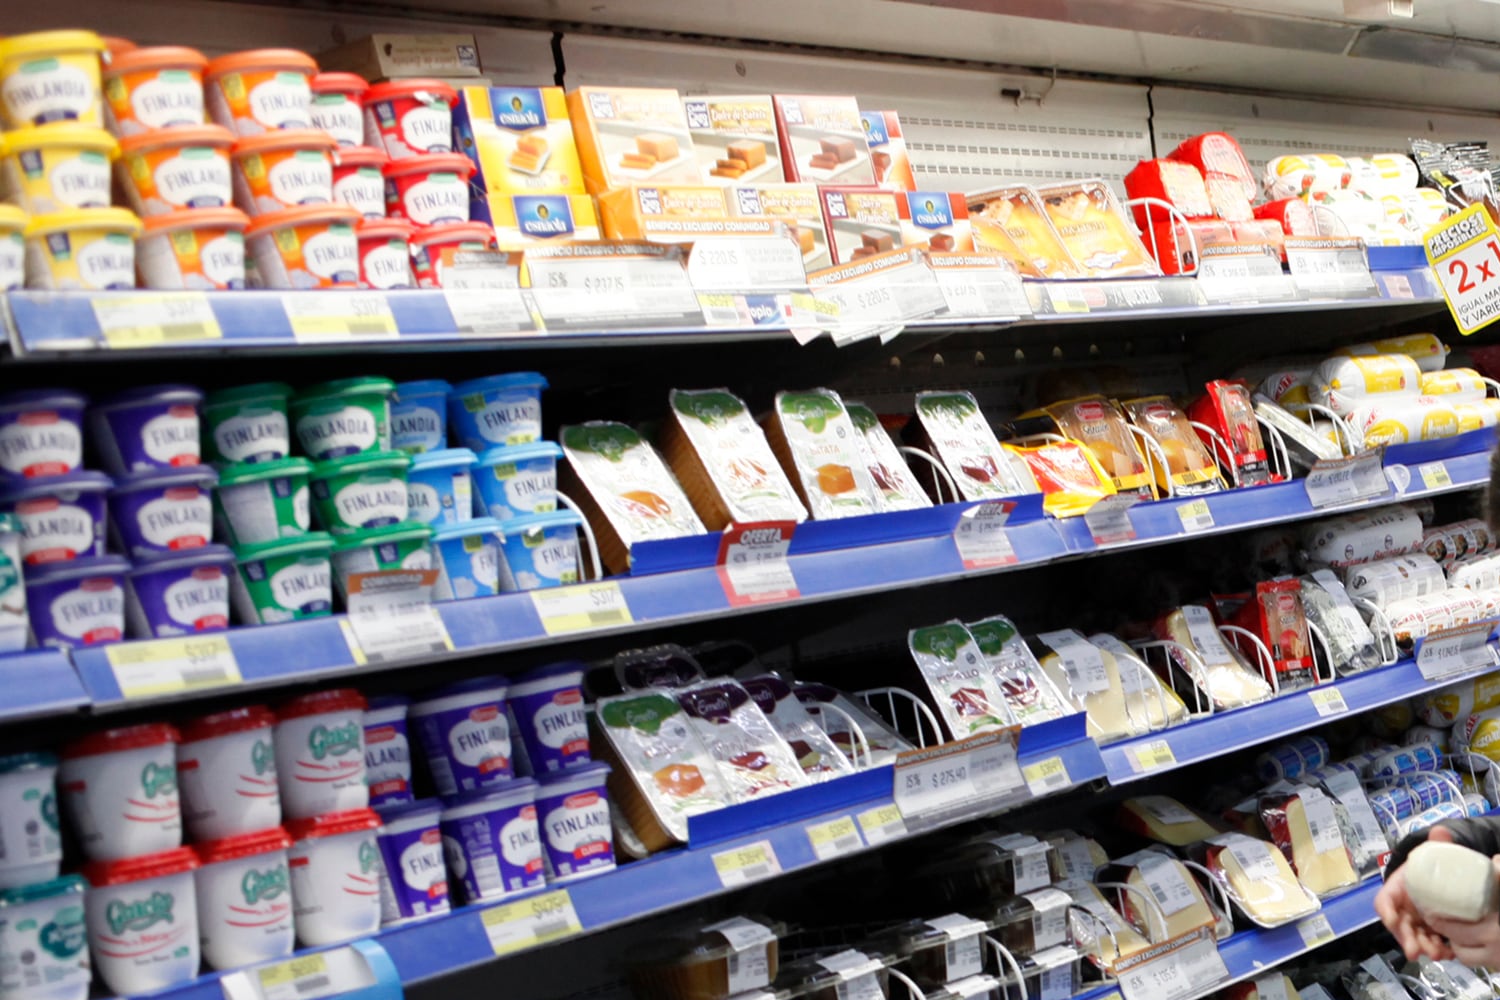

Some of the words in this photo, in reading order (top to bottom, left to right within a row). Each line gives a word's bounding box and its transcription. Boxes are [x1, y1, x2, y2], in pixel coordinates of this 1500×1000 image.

[682, 221, 724, 232] EXCLUSIVO
[724, 221, 770, 232] COMUNIDAD
[873, 252, 909, 272] COMUNIDAD
[1457, 289, 1486, 315] IGUAL
[1461, 313, 1472, 327] Y
[740, 528, 783, 546] OFERTA
